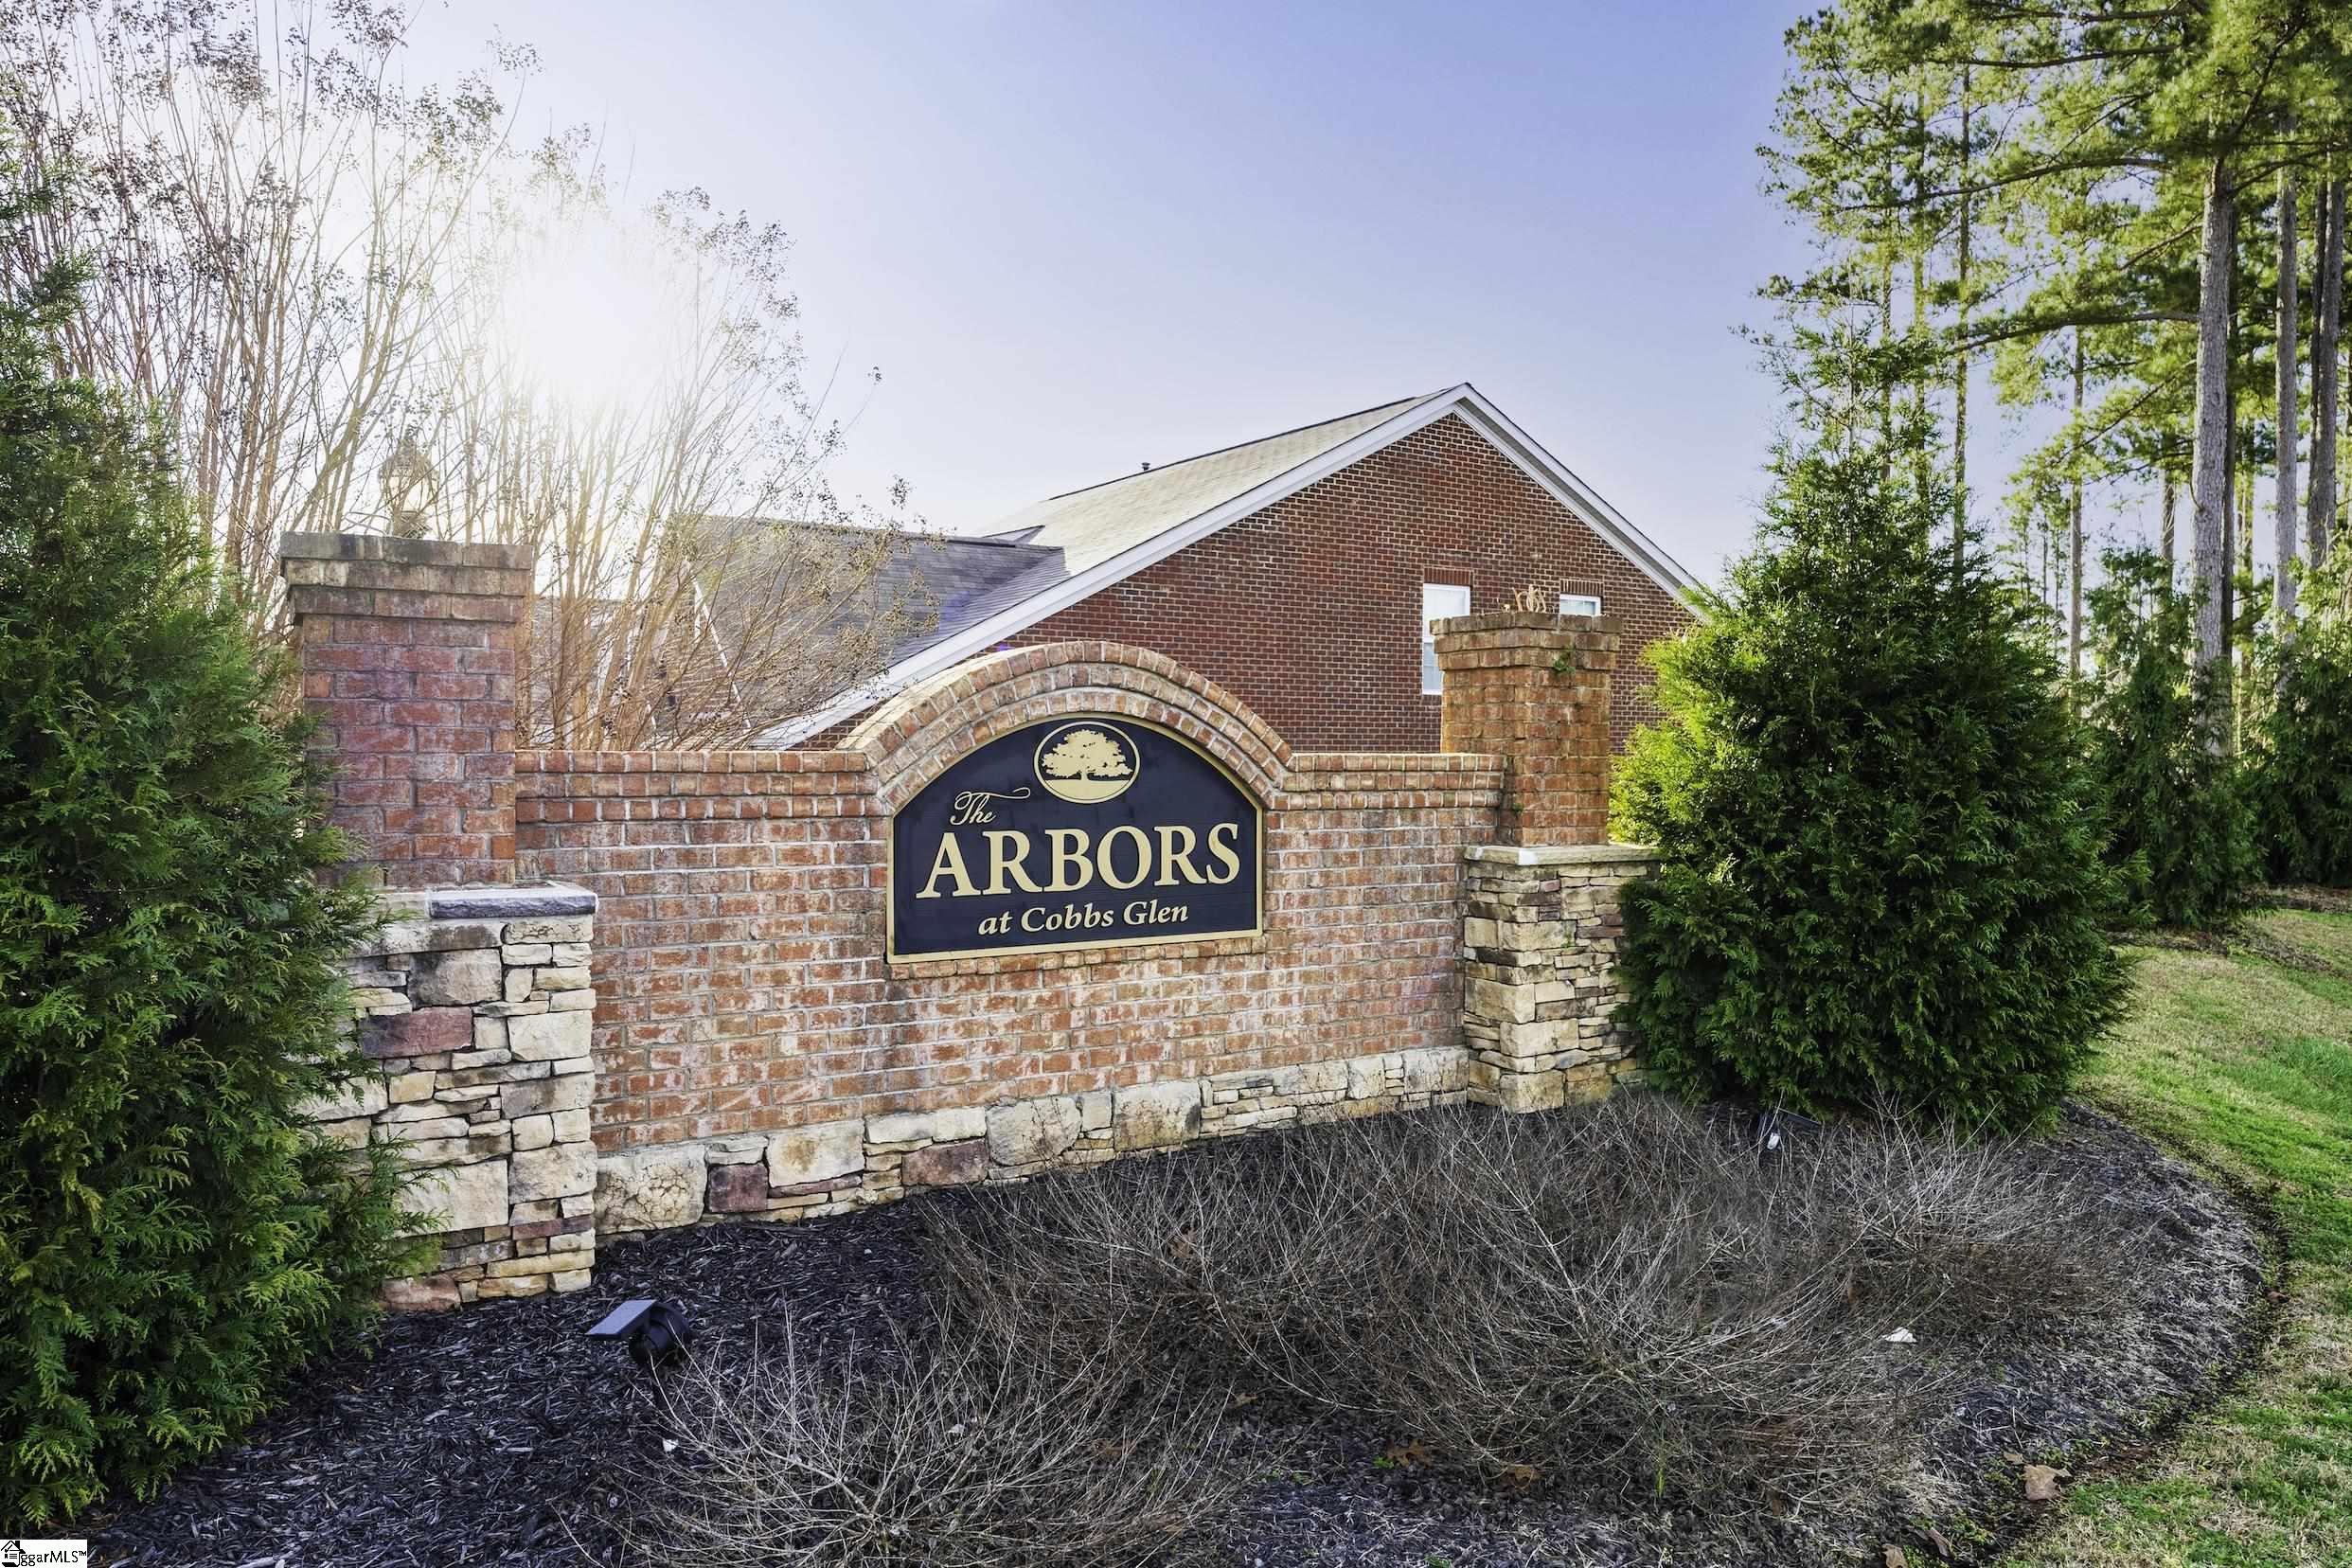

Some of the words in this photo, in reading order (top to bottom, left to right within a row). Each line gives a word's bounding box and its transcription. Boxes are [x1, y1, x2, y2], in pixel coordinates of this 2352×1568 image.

[950, 787, 1031, 827] The
[916, 823, 1241, 899] ARBORS
[977, 911, 1012, 935] at
[1020, 902, 1114, 932] Cobbs
[1123, 900, 1189, 927] Glen
